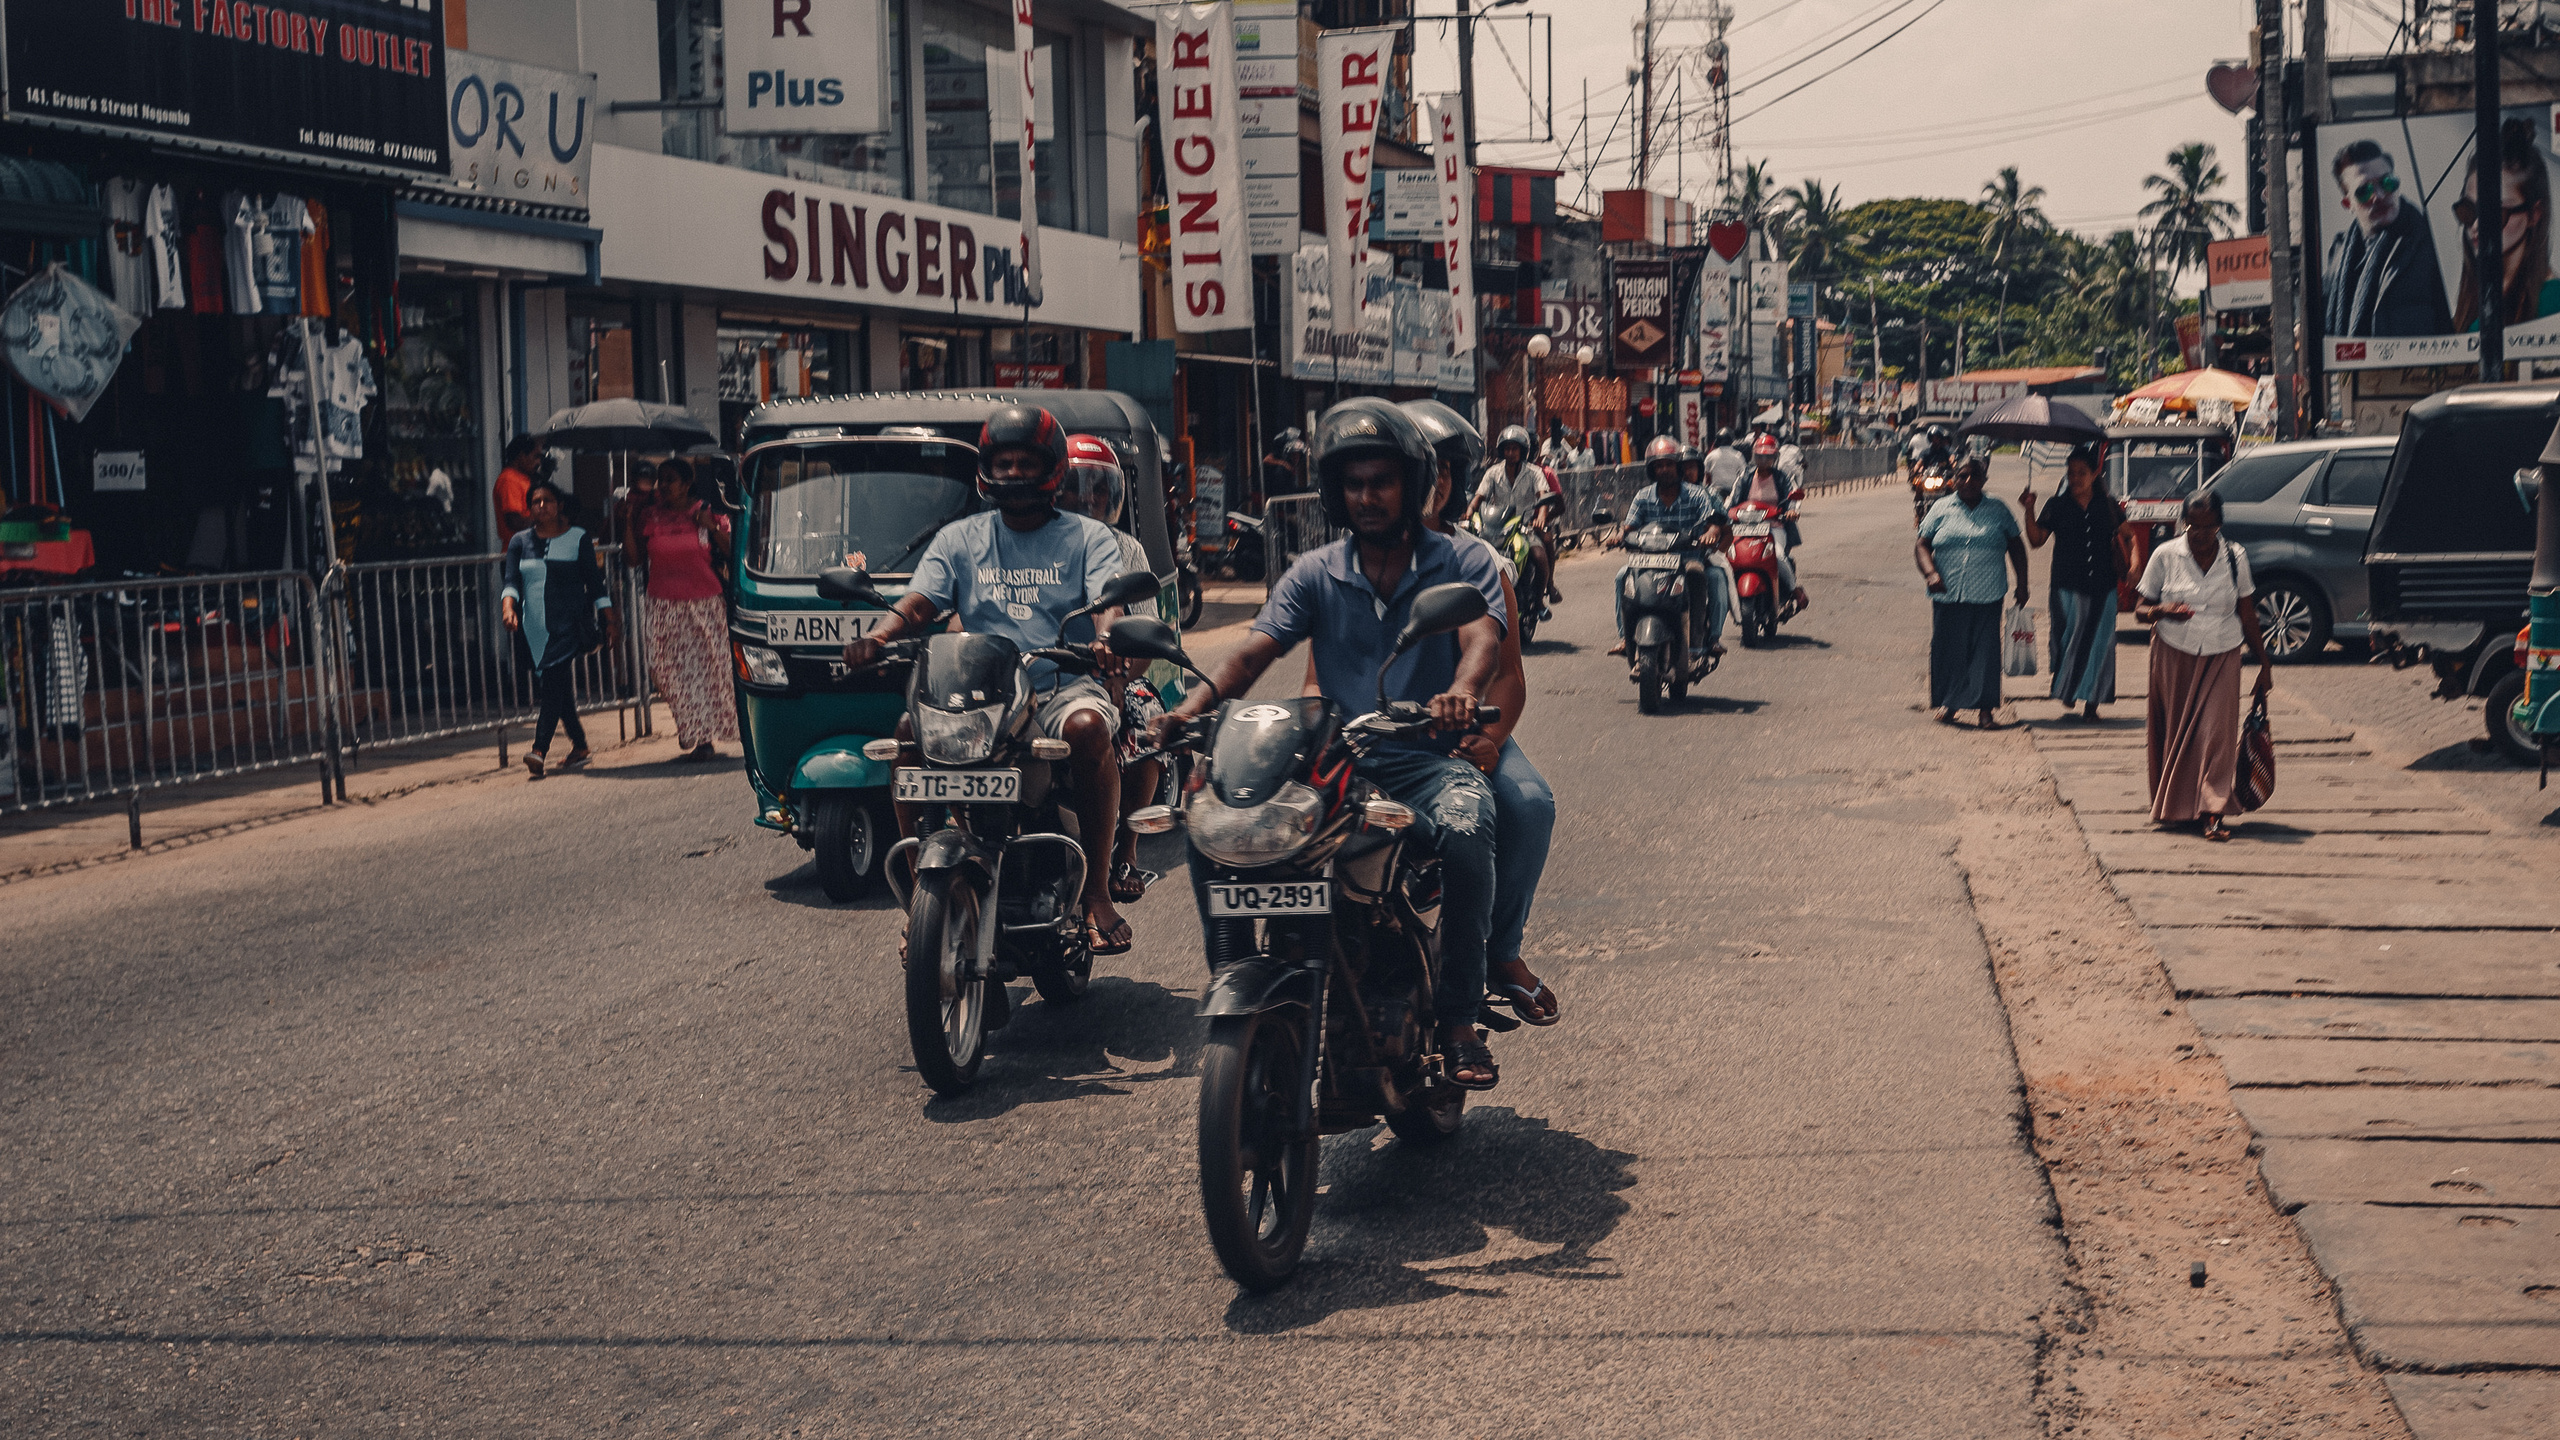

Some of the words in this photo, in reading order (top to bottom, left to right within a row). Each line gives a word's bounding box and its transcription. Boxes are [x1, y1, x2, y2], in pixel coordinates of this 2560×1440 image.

[193, 0, 328, 57] FACTORY
[339, 23, 433, 79] OUTLET
[747, 68, 845, 109] Plus
[100, 98, 138, 118] Street
[548, 91, 586, 164] U
[1172, 26, 1226, 318] SINGER
[761, 189, 979, 301] SINGER
[977, 566, 1001, 585] NIKE
[1001, 567, 1062, 586] BASKETBALL
[1014, 585, 1040, 605] YORK
[794, 617, 840, 641] ABN
[1224, 884, 1326, 910] UQ-2591
